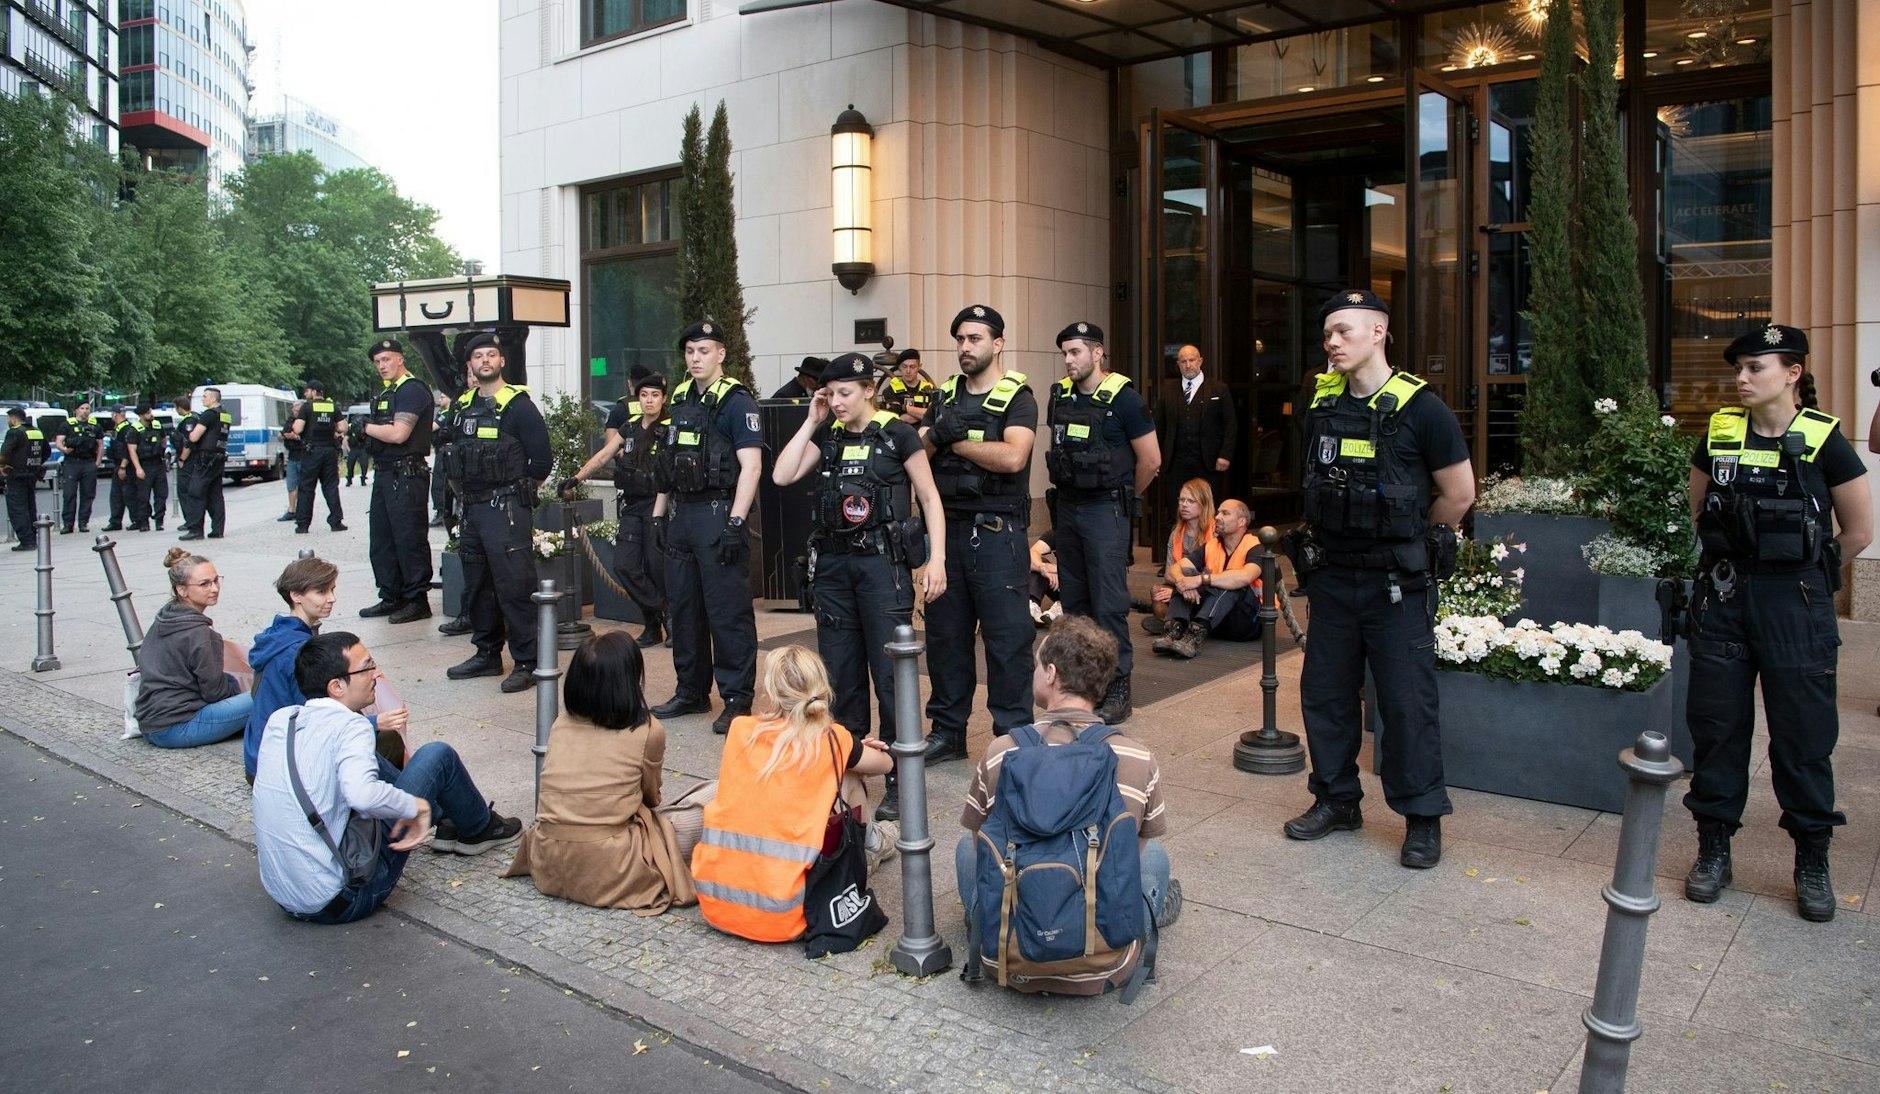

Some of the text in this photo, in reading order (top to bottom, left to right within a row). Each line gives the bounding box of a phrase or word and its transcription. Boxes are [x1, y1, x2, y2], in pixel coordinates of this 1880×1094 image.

[1069, 426, 1089, 437] POLIZEI
[1715, 456, 1737, 464] POLIZEI
[1743, 451, 1778, 465] POLIZEI
